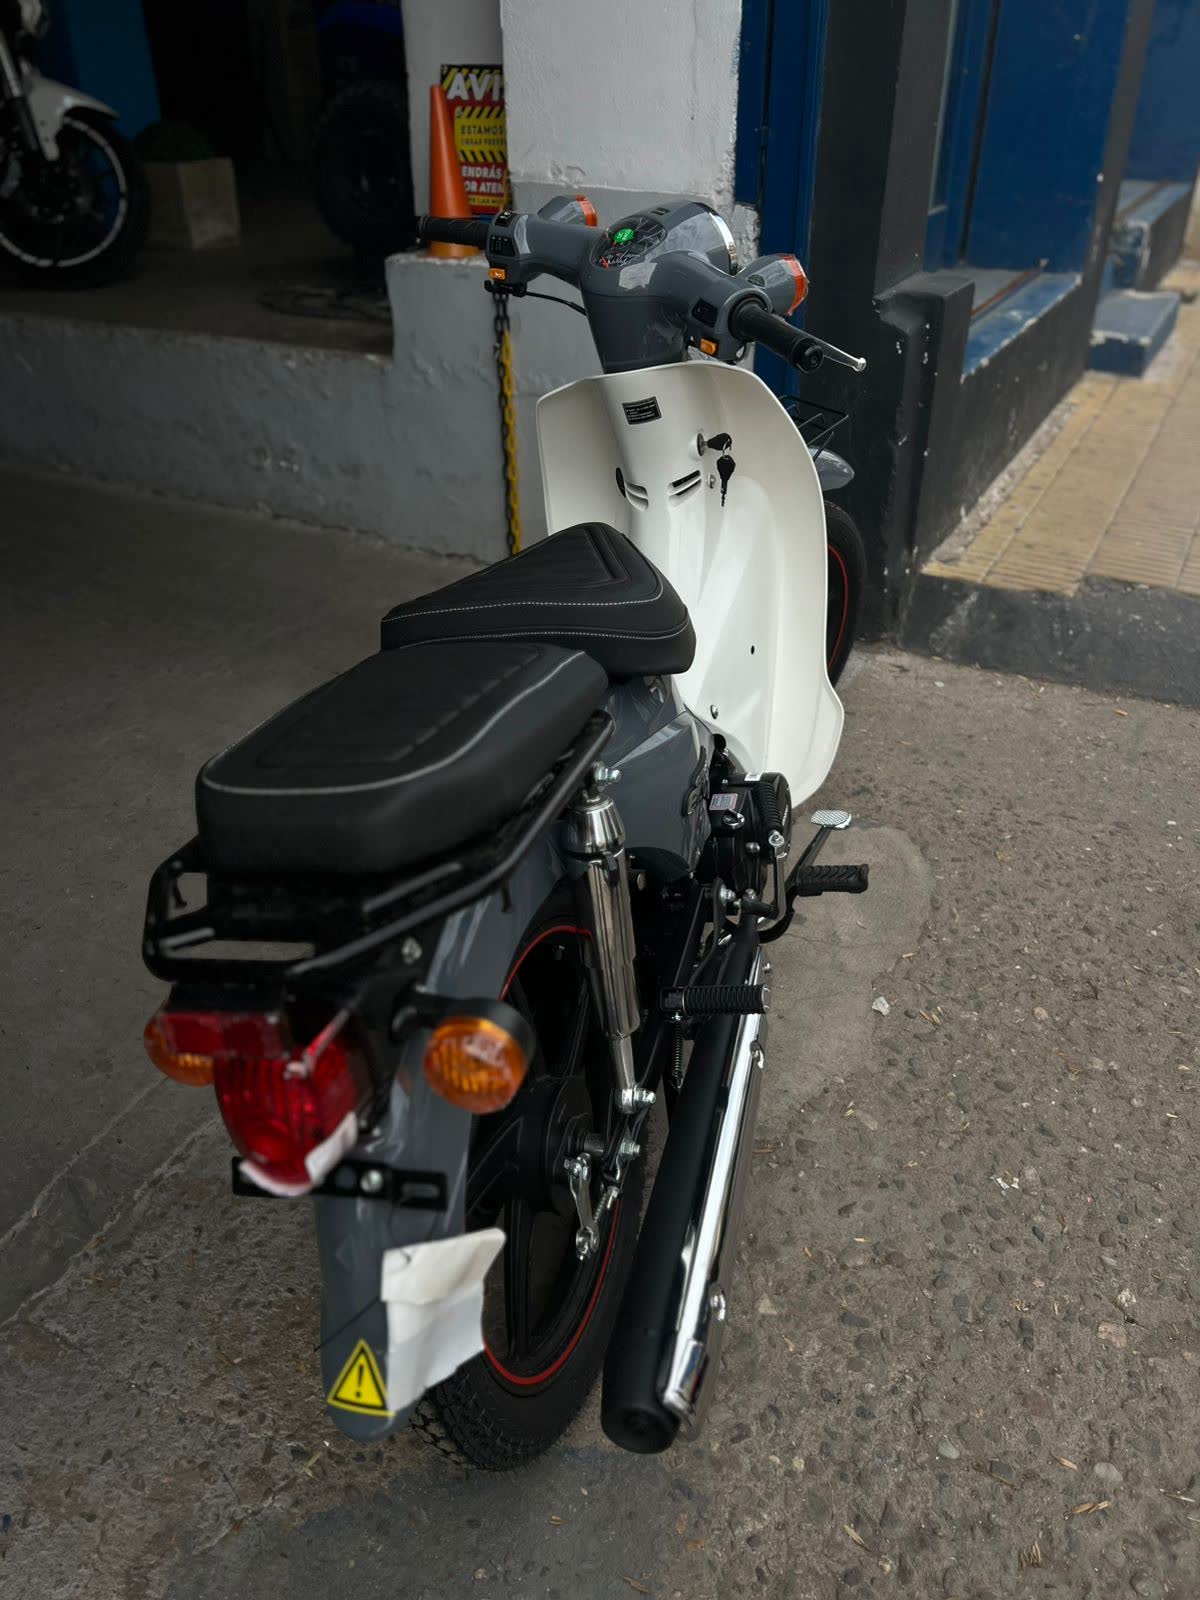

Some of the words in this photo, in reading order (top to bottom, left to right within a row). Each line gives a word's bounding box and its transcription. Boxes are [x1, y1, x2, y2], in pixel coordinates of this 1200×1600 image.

[447, 72, 501, 101] AVI
[461, 164, 502, 179] ENDRÁS
[479, 181, 505, 193] ATEN
